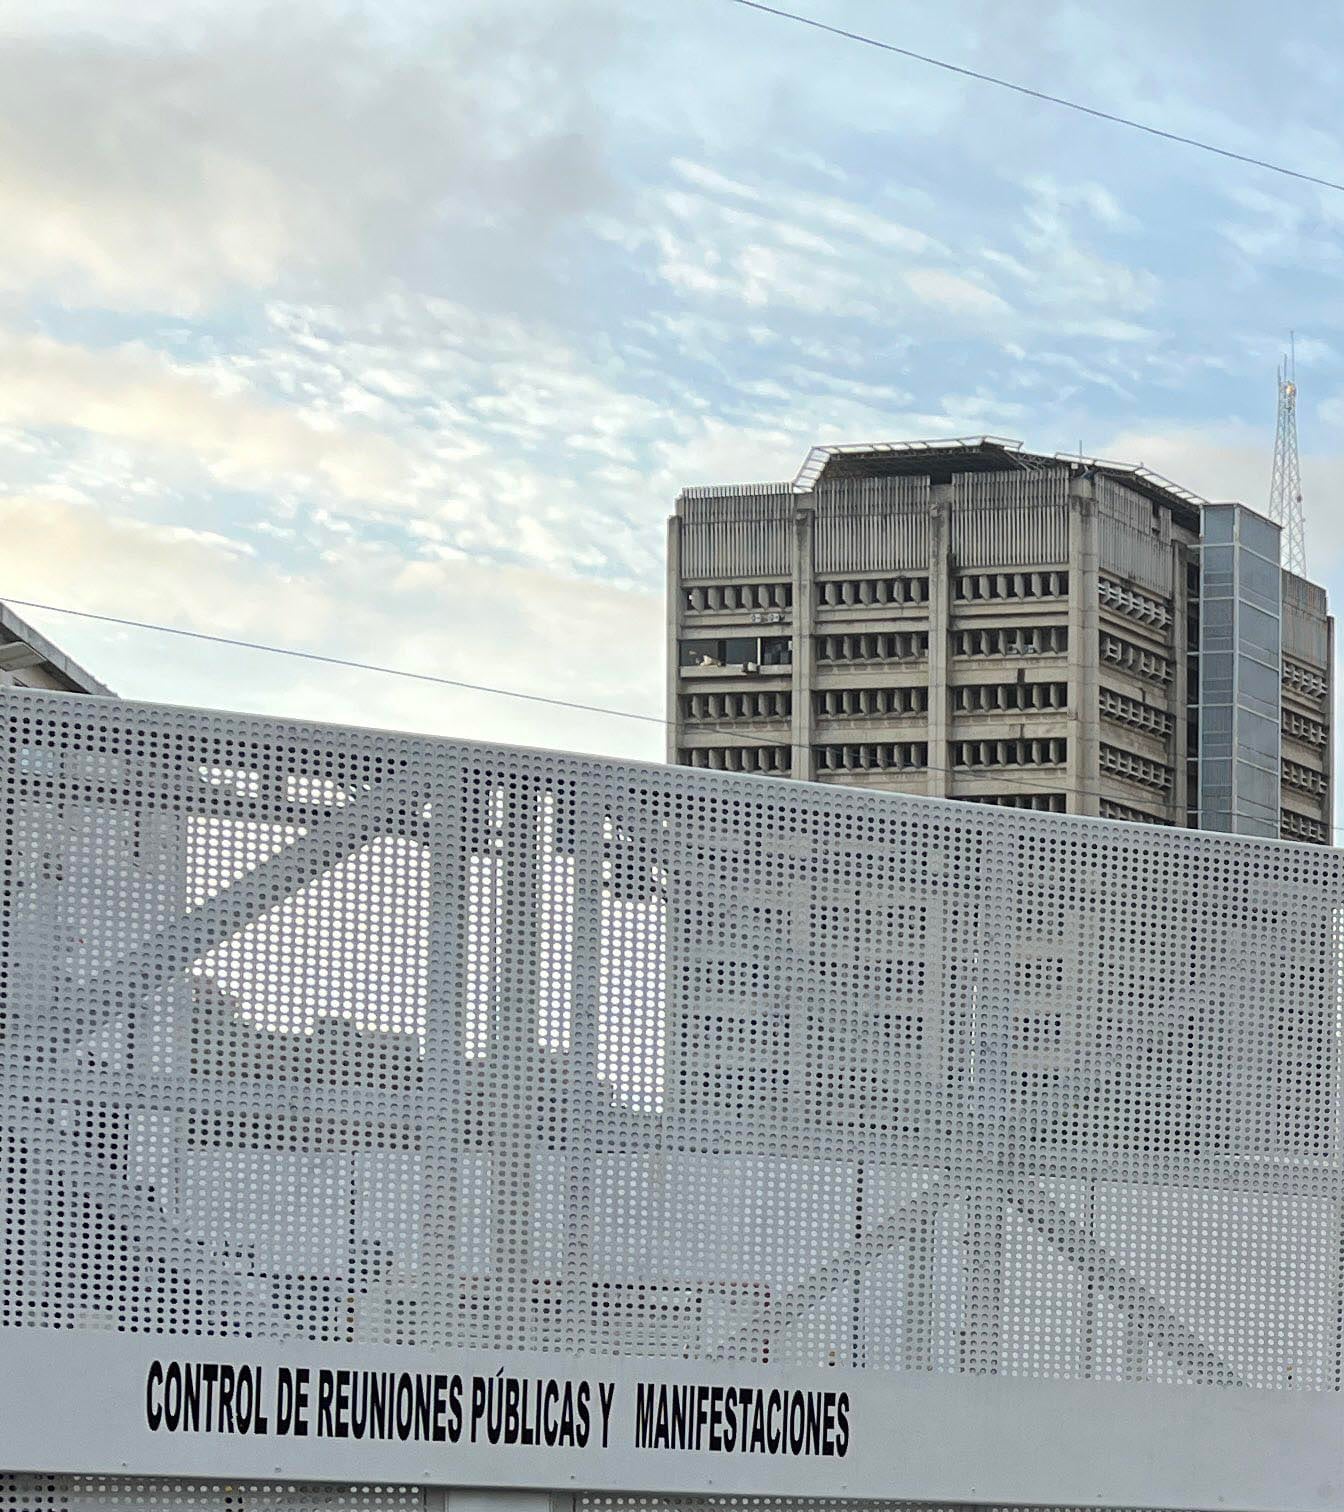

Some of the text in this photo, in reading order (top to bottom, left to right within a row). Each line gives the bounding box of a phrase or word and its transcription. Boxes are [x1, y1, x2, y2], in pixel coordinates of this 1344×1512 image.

[146, 1360, 850, 1457] CONTROL DE REUNIONES PÚBLICAS Y MANIFESTACIONES
